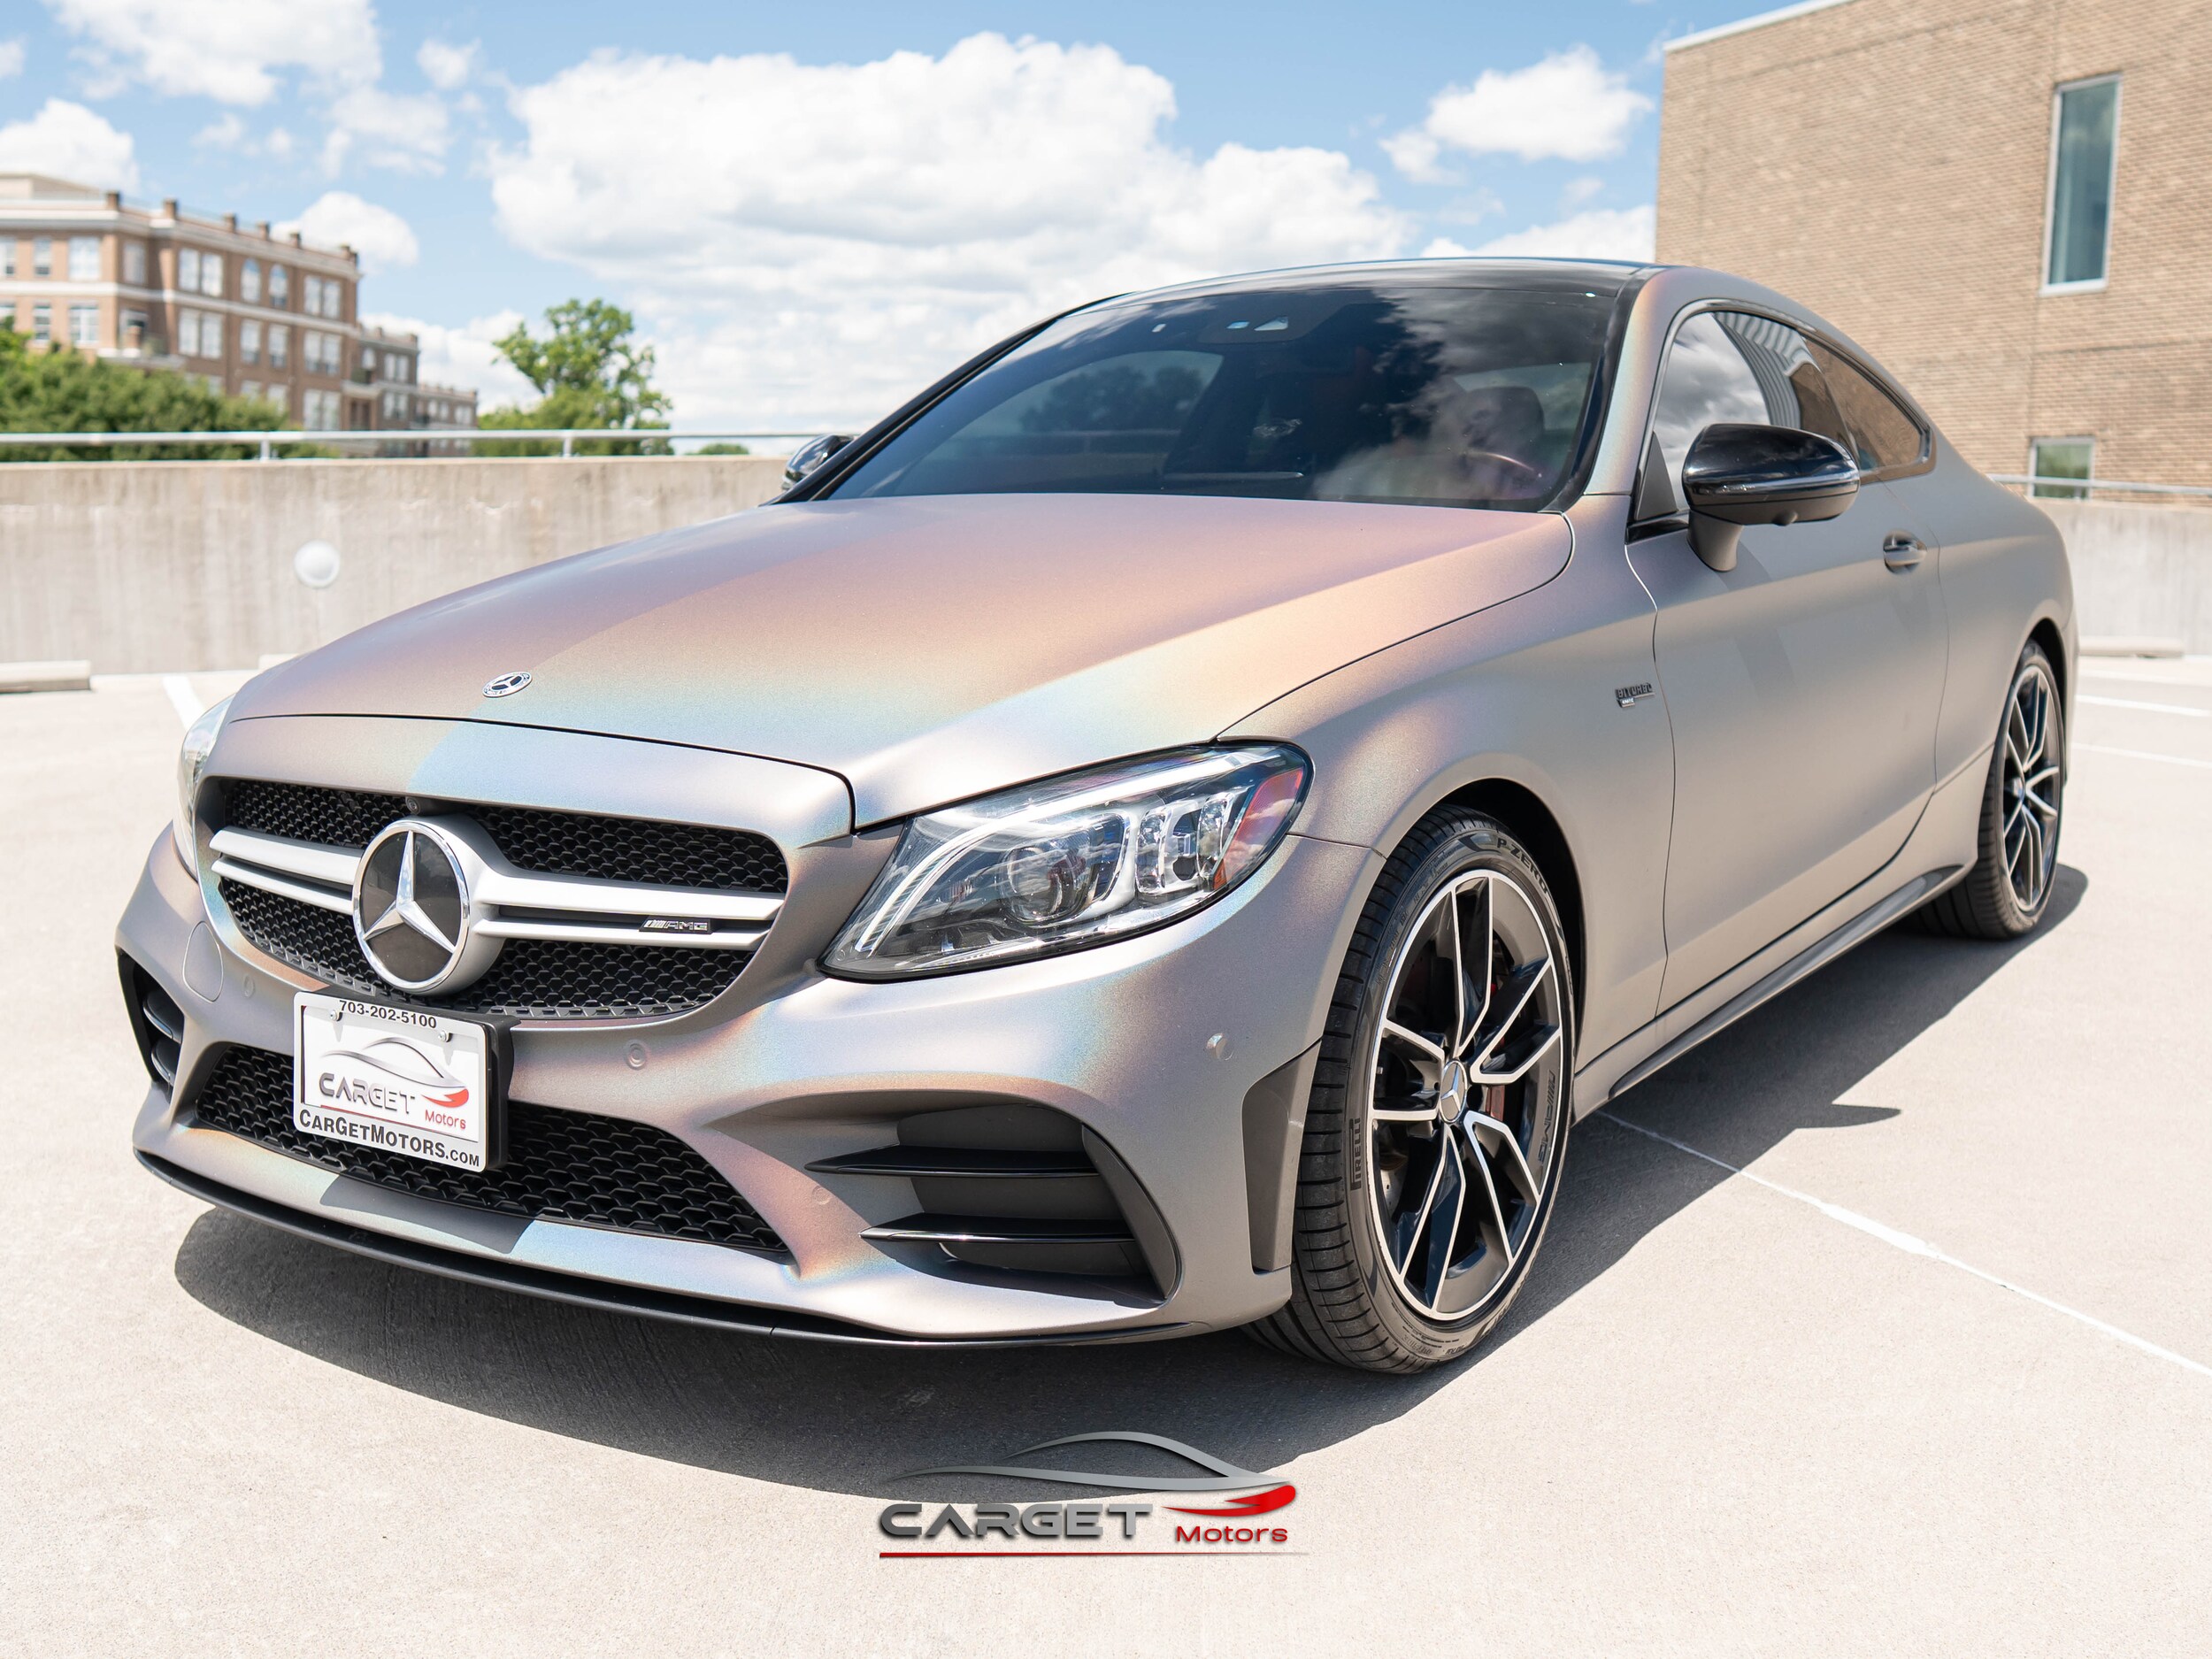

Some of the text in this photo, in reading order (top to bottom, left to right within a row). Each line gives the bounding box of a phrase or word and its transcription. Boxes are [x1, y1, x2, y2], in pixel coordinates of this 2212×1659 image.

[339, 1000, 437, 1029] 703-202-5100
[319, 1072, 416, 1115] CARGET
[425, 1110, 467, 1131] Motors
[1349, 1118, 1362, 1191] PIRELLI
